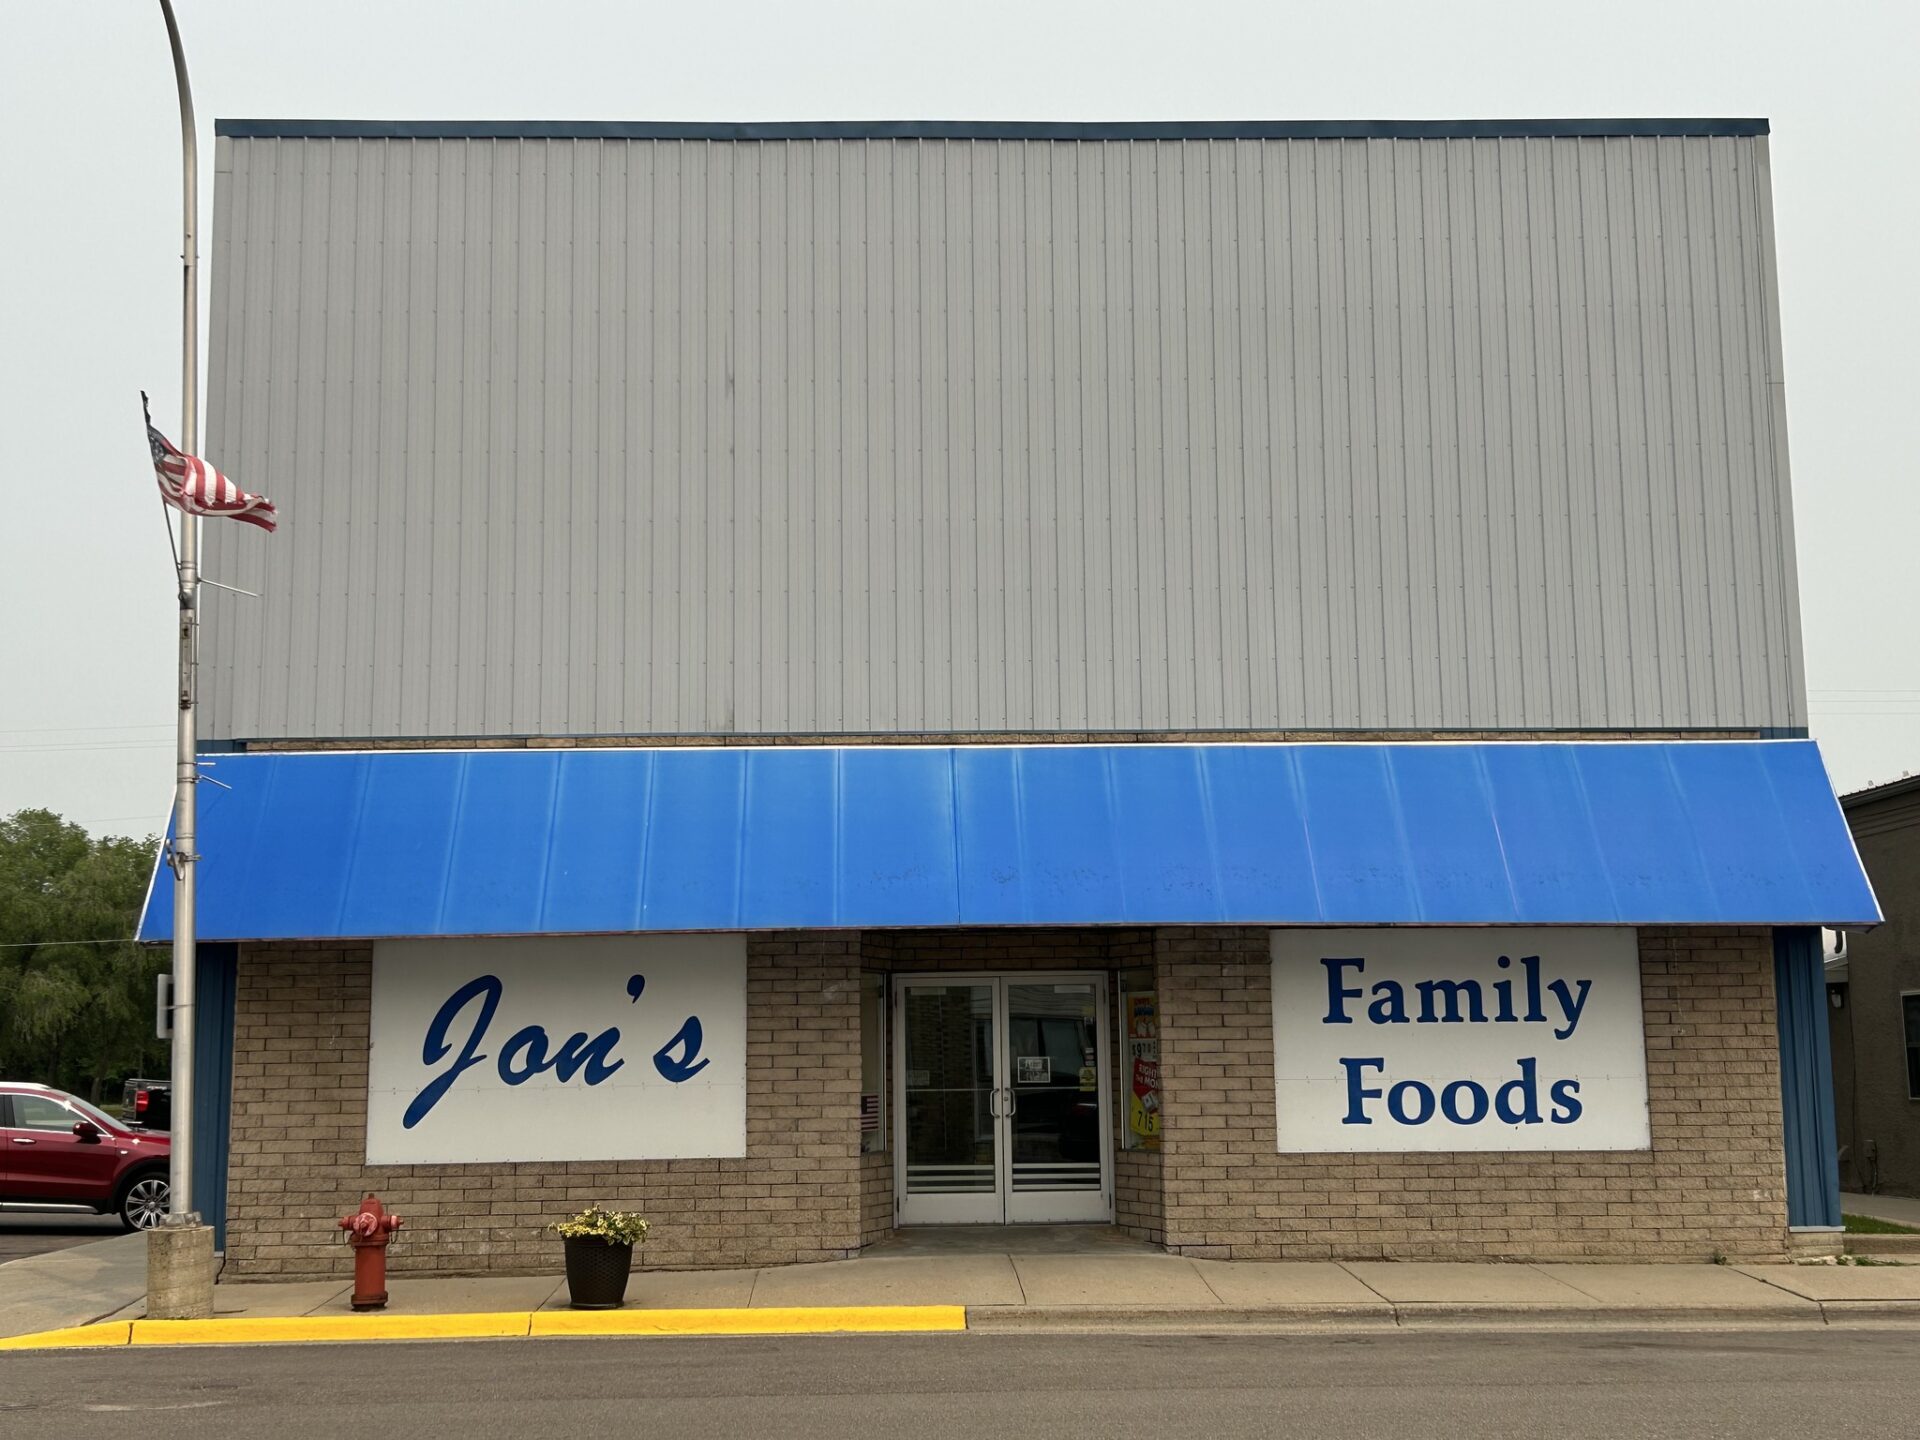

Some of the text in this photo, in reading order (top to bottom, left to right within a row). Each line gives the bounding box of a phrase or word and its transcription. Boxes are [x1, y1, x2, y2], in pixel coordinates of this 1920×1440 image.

[1320, 955, 1592, 1040] Family
[402, 974, 710, 1129] Jon's
[1338, 1056, 1584, 1125] Foods
